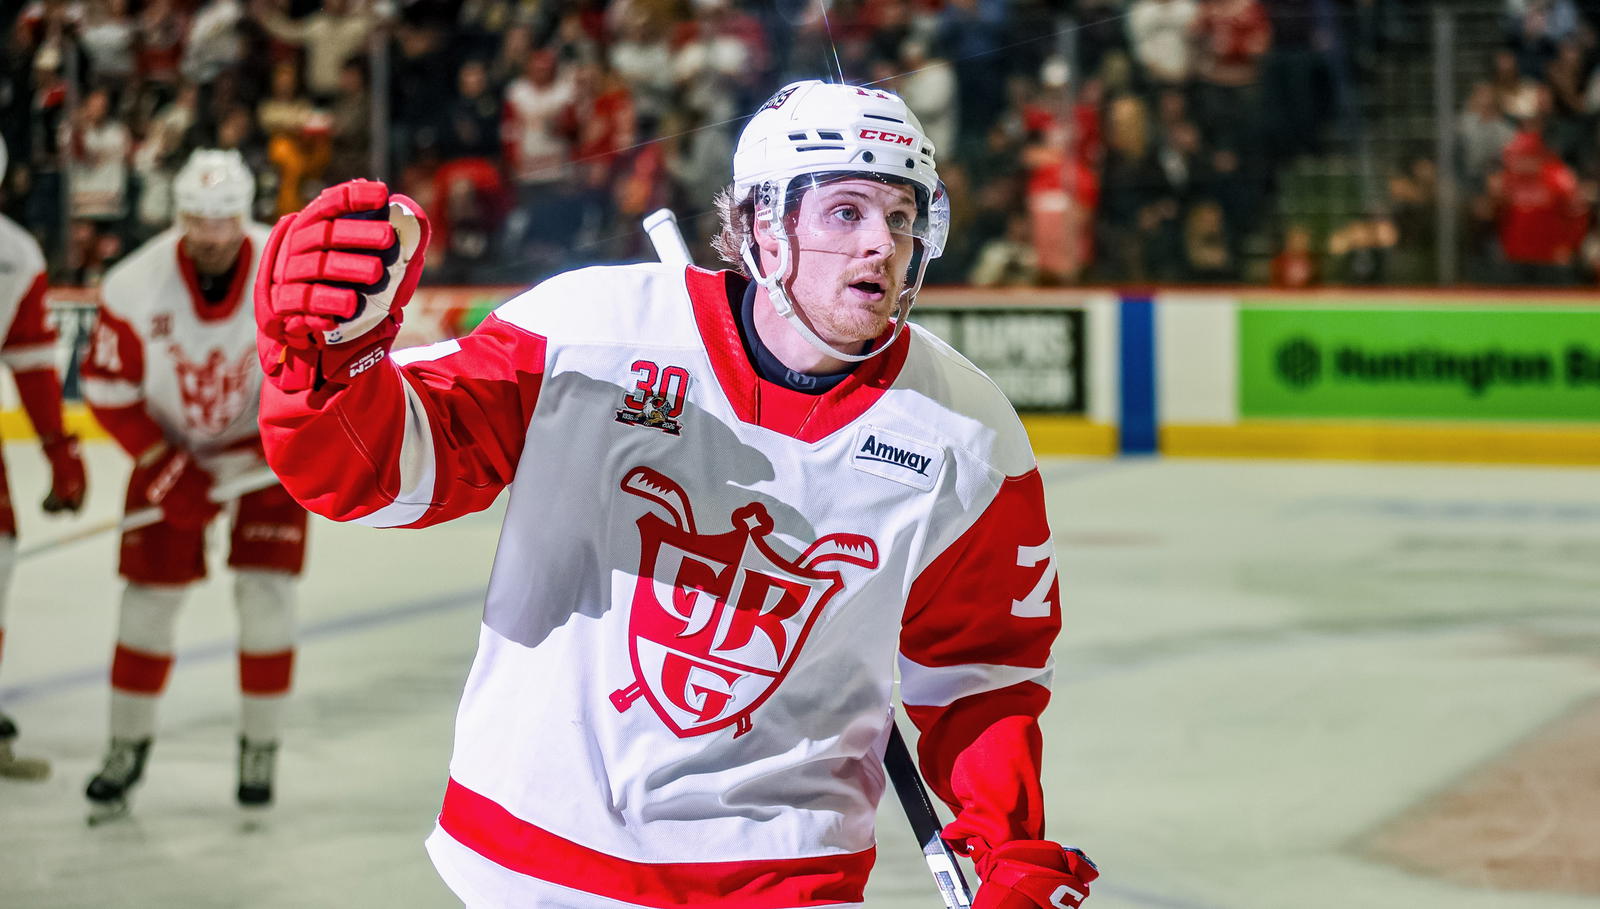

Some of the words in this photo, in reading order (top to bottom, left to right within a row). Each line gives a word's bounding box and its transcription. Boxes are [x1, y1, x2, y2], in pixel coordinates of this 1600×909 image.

[860, 129, 913, 146] CCM
[349, 349, 385, 378] CCM
[1333, 346, 1554, 397] Huntington
[624, 359, 690, 418] 30
[860, 434, 932, 474] Amway
[1010, 538, 1058, 618] 7
